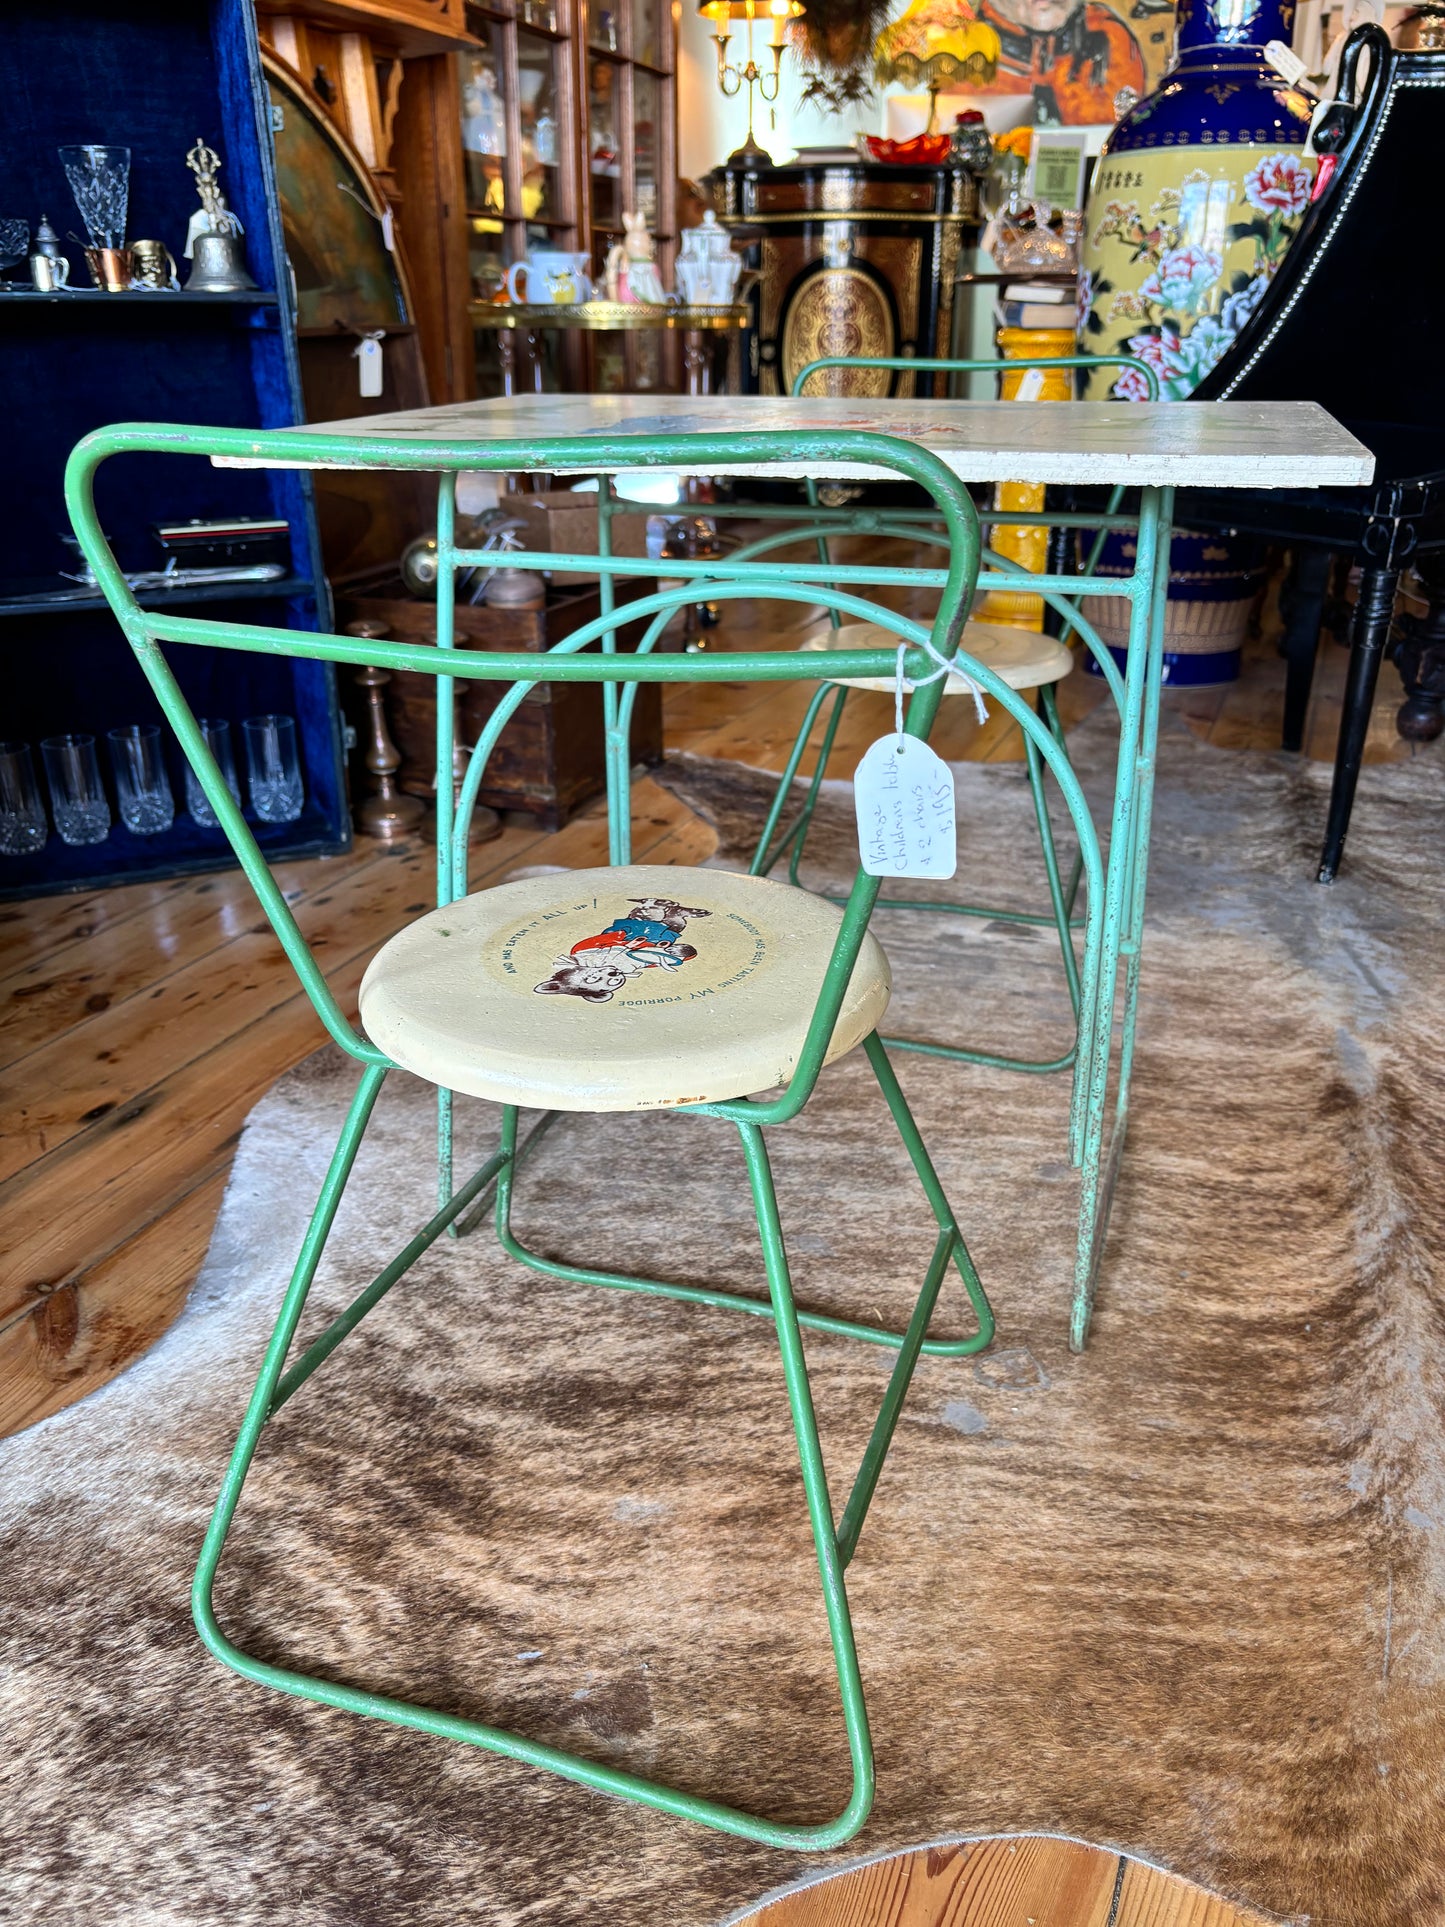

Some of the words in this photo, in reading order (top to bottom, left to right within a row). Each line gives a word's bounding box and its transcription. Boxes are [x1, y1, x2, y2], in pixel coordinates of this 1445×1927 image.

[869, 803, 888, 865] Vintage
[542, 910, 568, 921] ALL
[726, 912, 762, 936] SOMEBODY
[505, 928, 530, 947] EATEN
[755, 939, 766, 949] HAS
[502, 949, 513, 960] HAS
[750, 951, 766, 965] BEEN
[502, 962, 518, 974] AND
[717, 967, 754, 988] TASTING
[690, 987, 716, 1000] MY
[618, 995, 683, 1007] PORRIDGE
